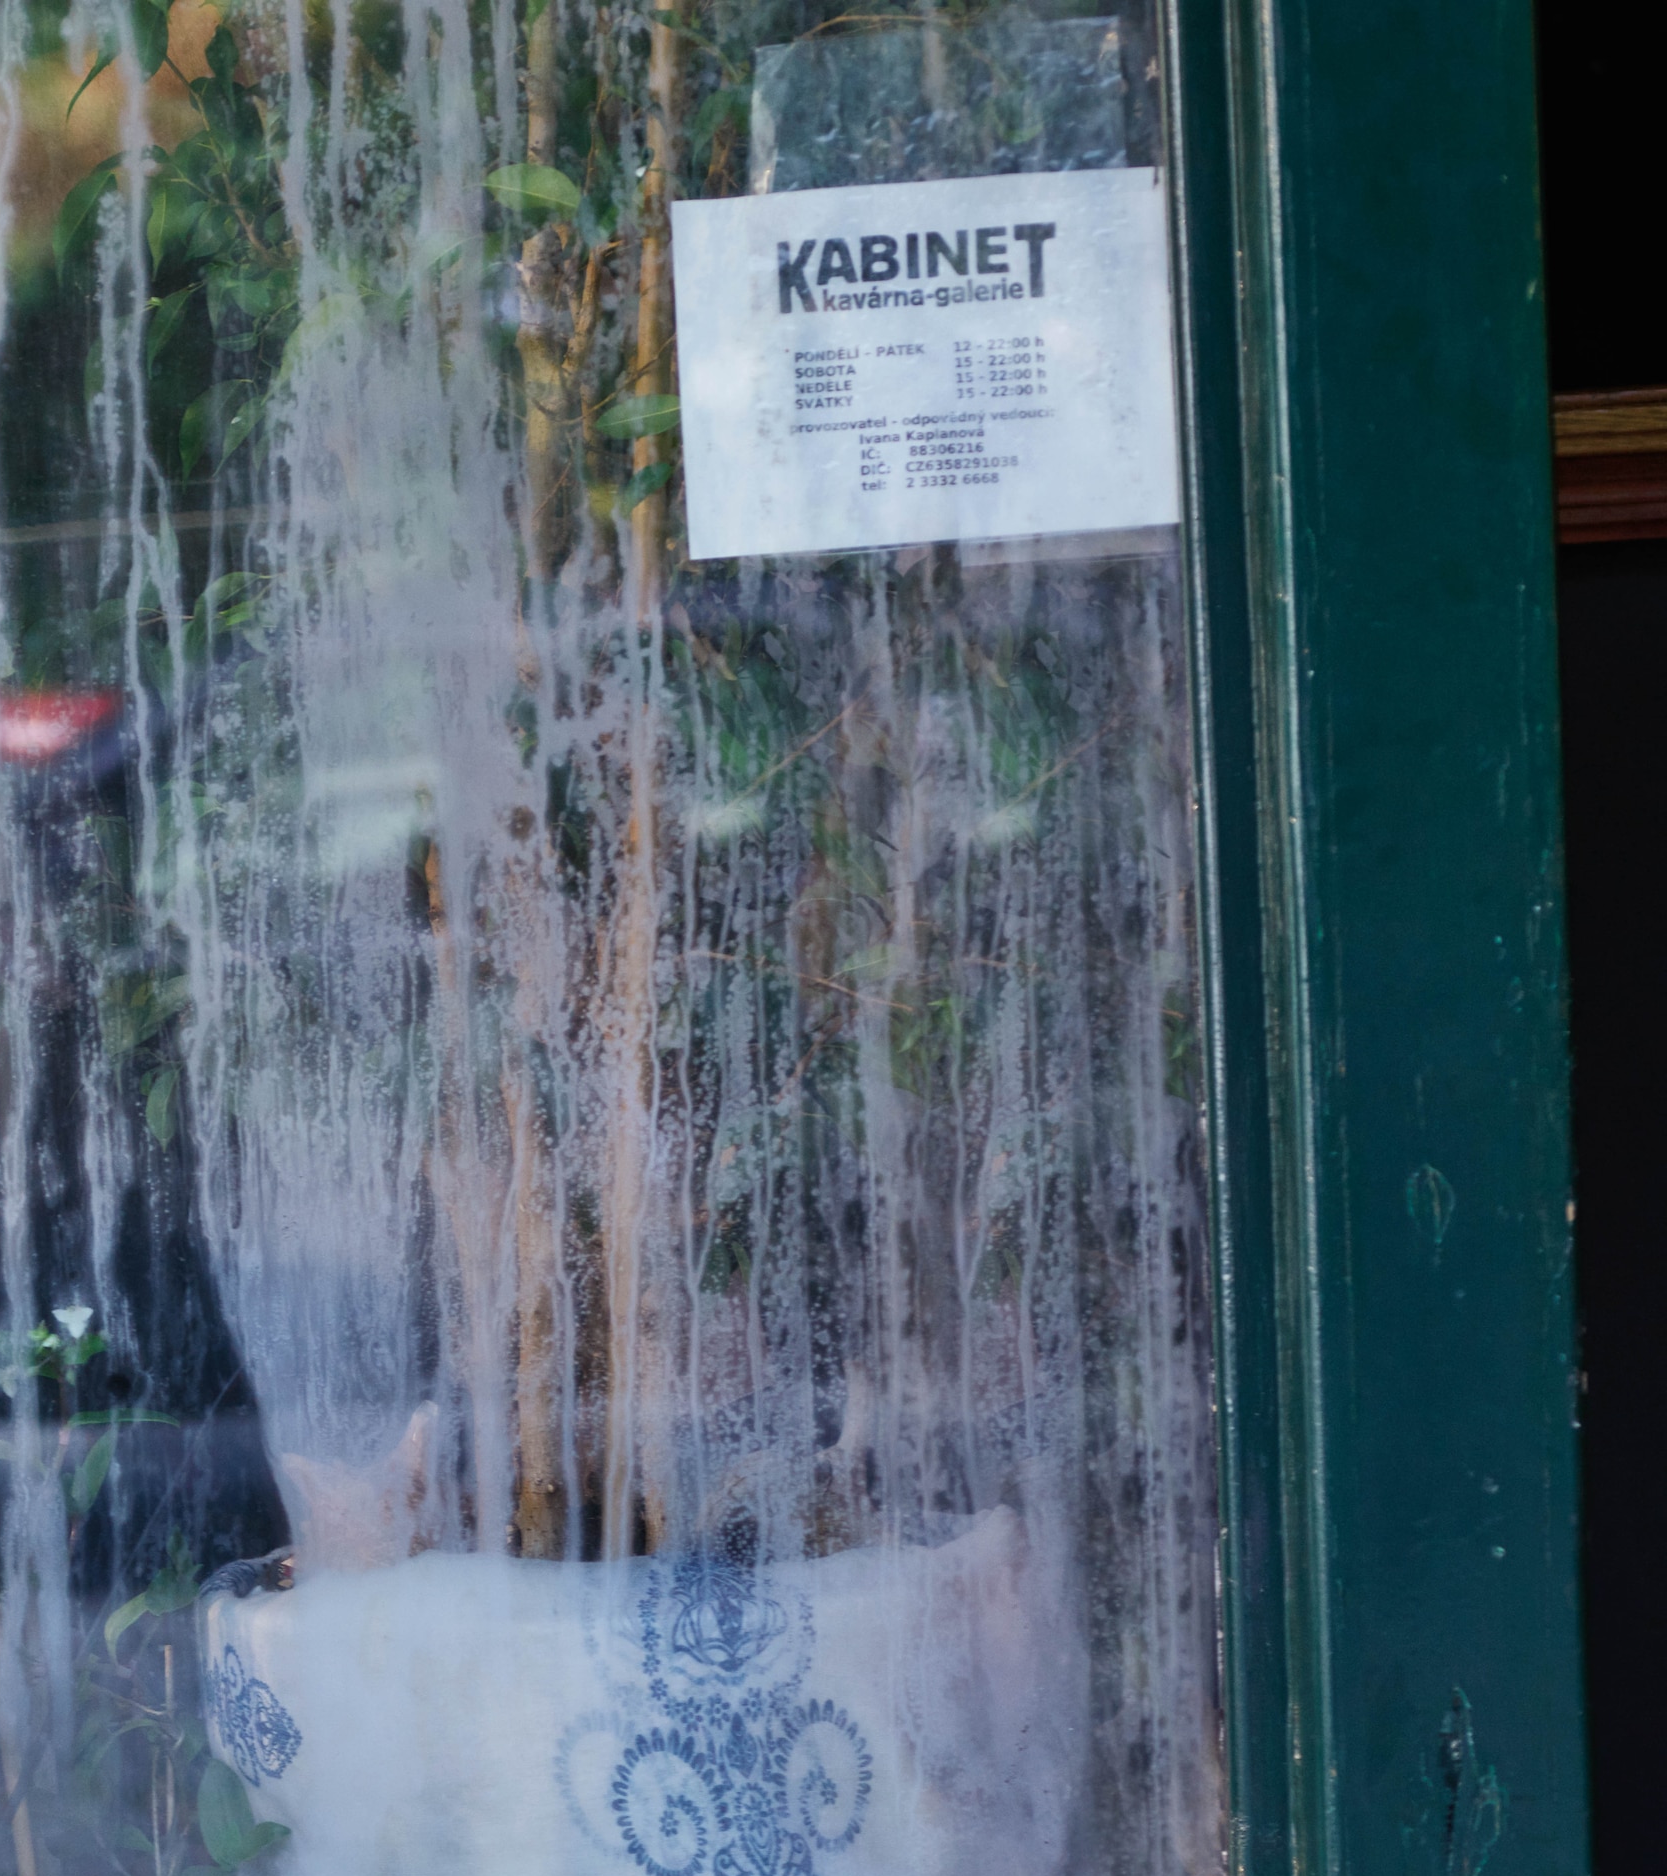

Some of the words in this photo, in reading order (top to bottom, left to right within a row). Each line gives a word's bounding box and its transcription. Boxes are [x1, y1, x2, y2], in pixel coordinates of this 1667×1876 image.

[777, 221, 1055, 313] KABINET
[822, 277, 1024, 313] kavárna-galerie
[953, 341, 972, 352] 12
[1035, 336, 1044, 347] h
[794, 364, 856, 379] SOBOTA
[954, 356, 973, 368] 15
[988, 353, 1032, 366] 22:00
[1036, 352, 1045, 363] h
[955, 371, 974, 383] 15
[989, 368, 1032, 381] 22:00
[1037, 368, 1046, 379] h
[956, 387, 975, 399] 15
[990, 384, 1034, 397] 22:00
[1038, 384, 1047, 395] h
[790, 416, 887, 435] provozovatel
[859, 433, 901, 445] Ivana
[860, 461, 891, 476] DIČ:
[861, 479, 887, 491] tel:
[905, 477, 915, 488] 2
[920, 474, 957, 488] 3332
